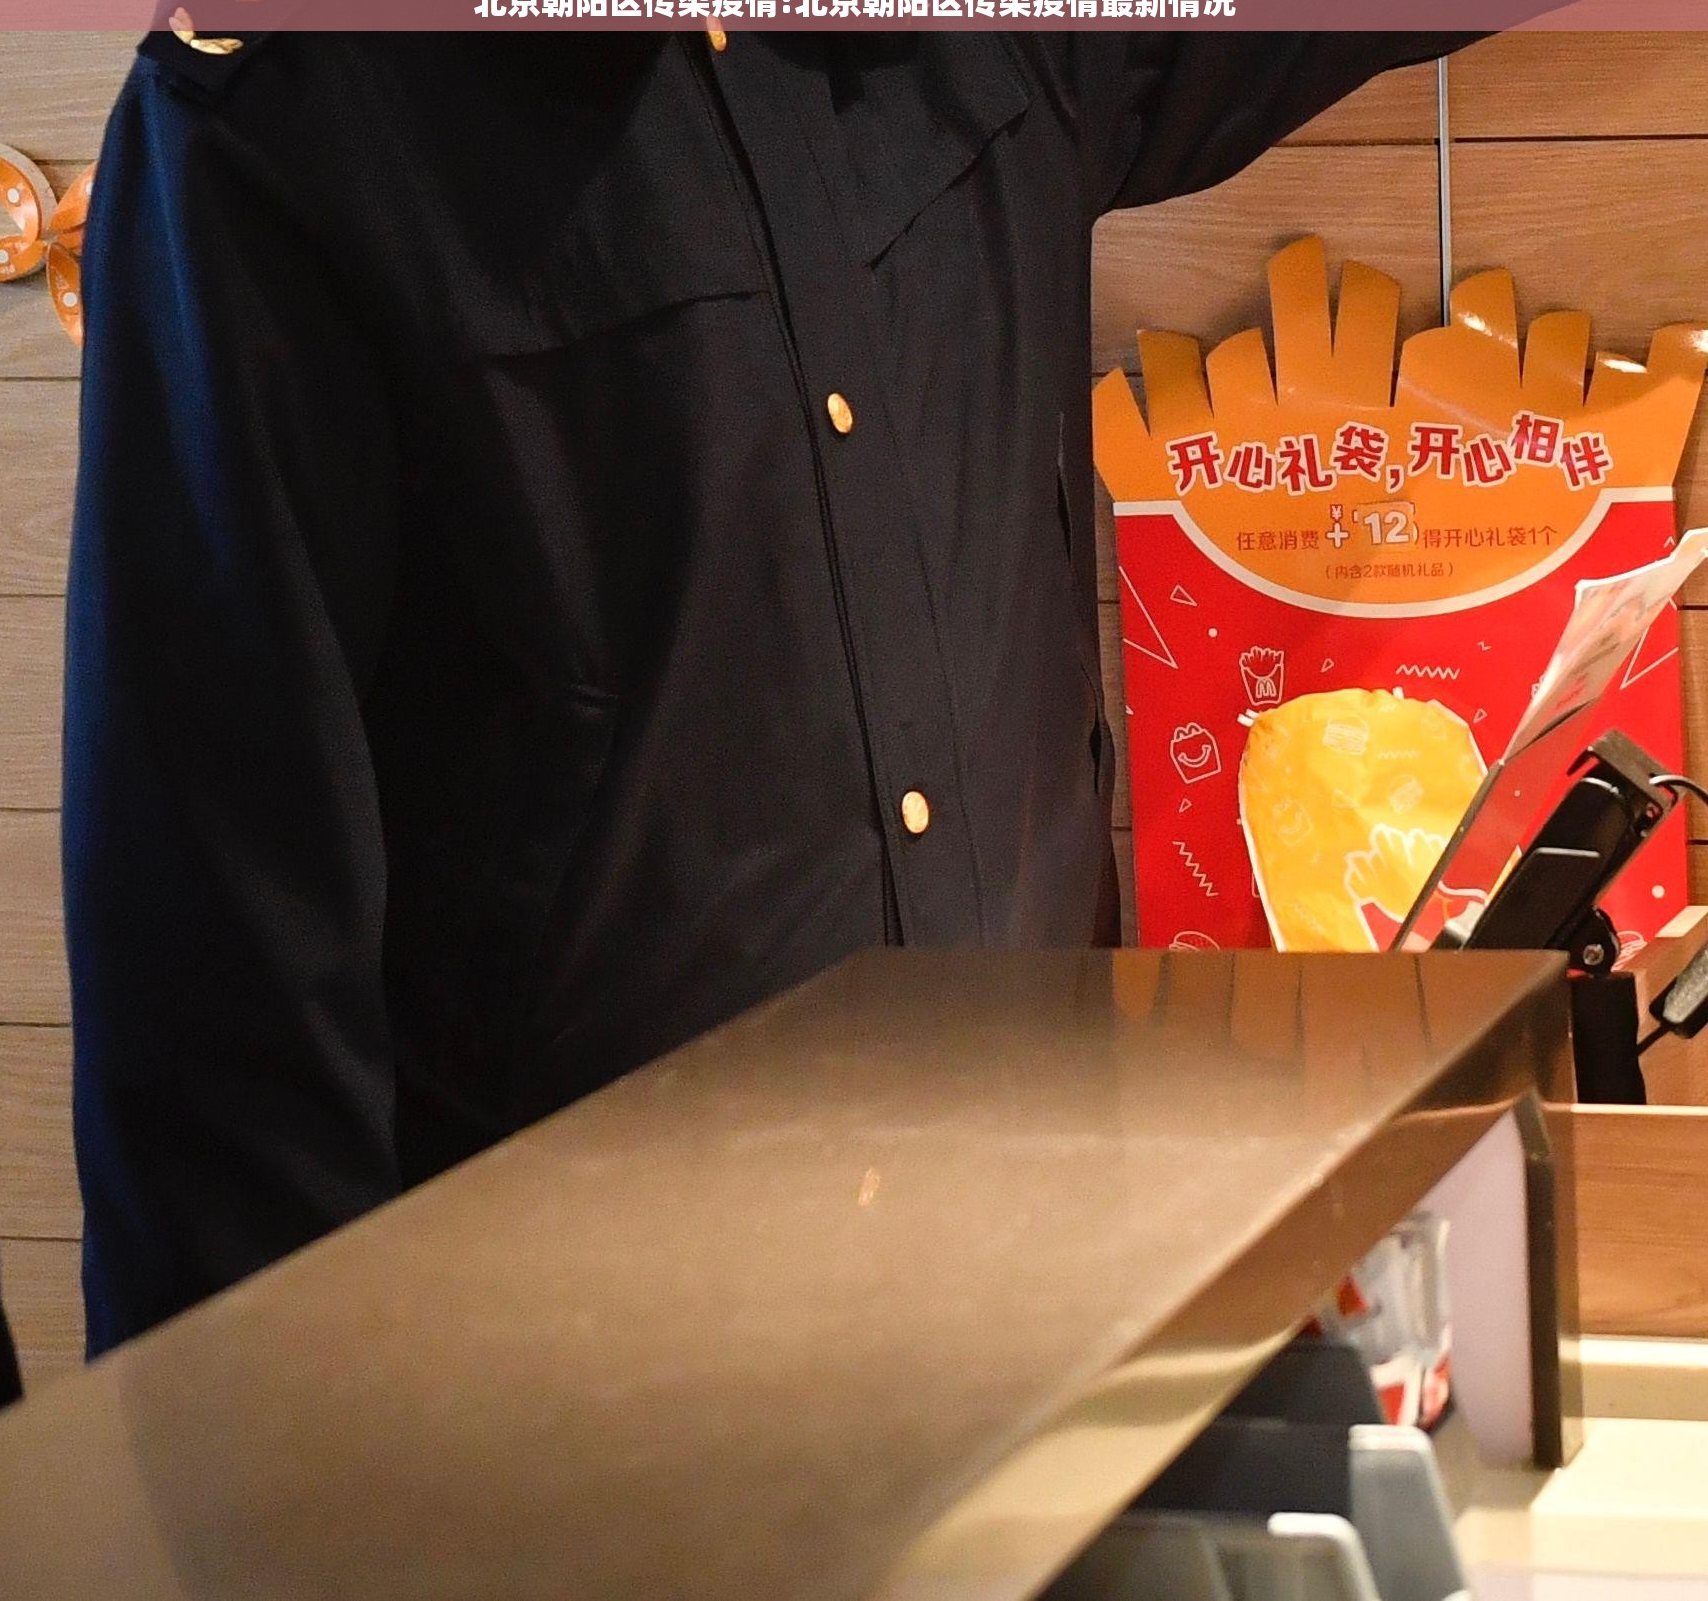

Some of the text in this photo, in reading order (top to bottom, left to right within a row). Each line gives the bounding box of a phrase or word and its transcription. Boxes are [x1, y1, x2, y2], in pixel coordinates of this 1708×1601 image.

[1237, 531, 1320, 550] 任意消费
[1364, 511, 1411, 545] 12
[1423, 526, 1558, 548] 得开心礼袋1个
